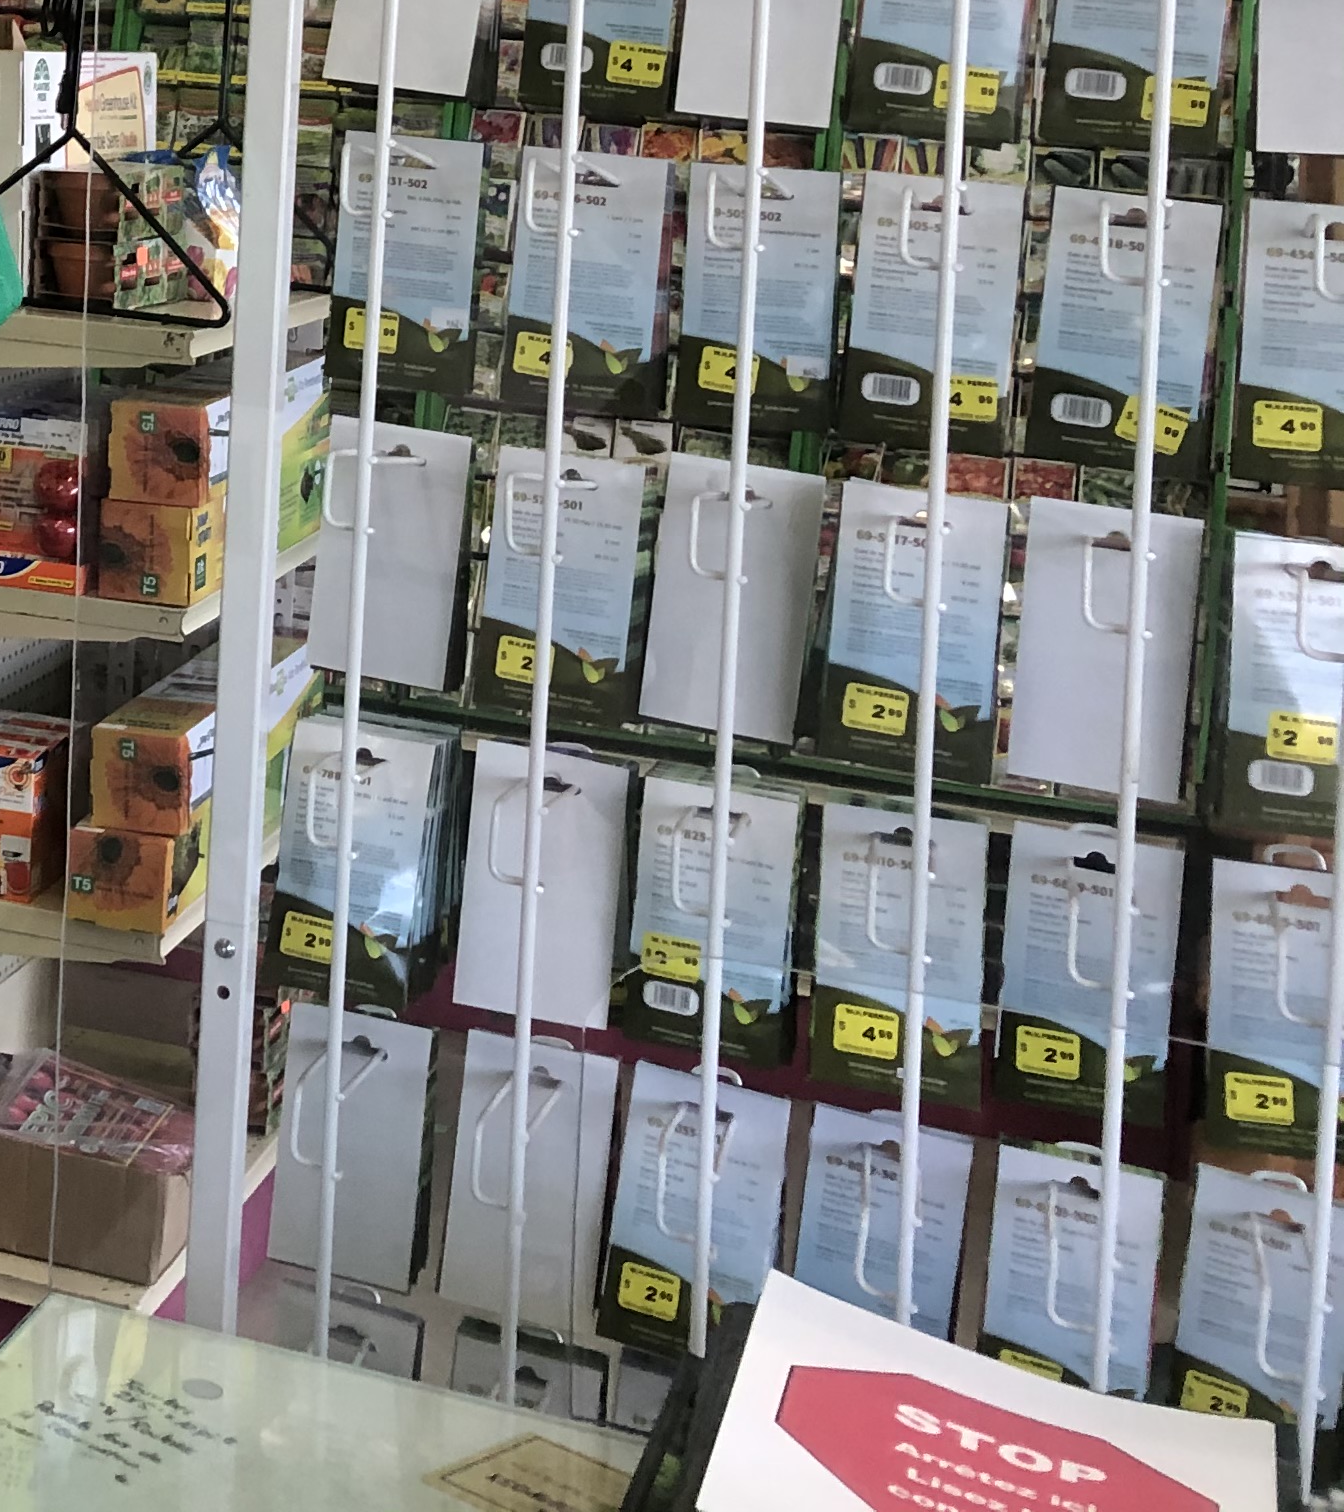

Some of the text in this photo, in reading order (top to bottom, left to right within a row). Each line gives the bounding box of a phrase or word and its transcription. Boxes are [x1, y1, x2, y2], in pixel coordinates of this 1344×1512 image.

[620, 57, 633, 73] 4
[141, 414, 155, 432] T5
[1280, 419, 1296, 434] 4
[143, 576, 157, 594] T5
[521, 655, 533, 670] 2
[871, 704, 886, 719] 2
[1282, 730, 1298, 747] 2
[121, 739, 135, 758] T5
[72, 875, 92, 891] T5
[304, 932, 317, 948] 2
[862, 1025, 877, 1041] 4
[1043, 1047, 1059, 1063] 2
[1255, 1093, 1270, 1109] 2
[644, 1285, 658, 1303] 2
[1209, 1395, 1224, 1412] 2
[894, 1403, 1108, 1484] STOP
